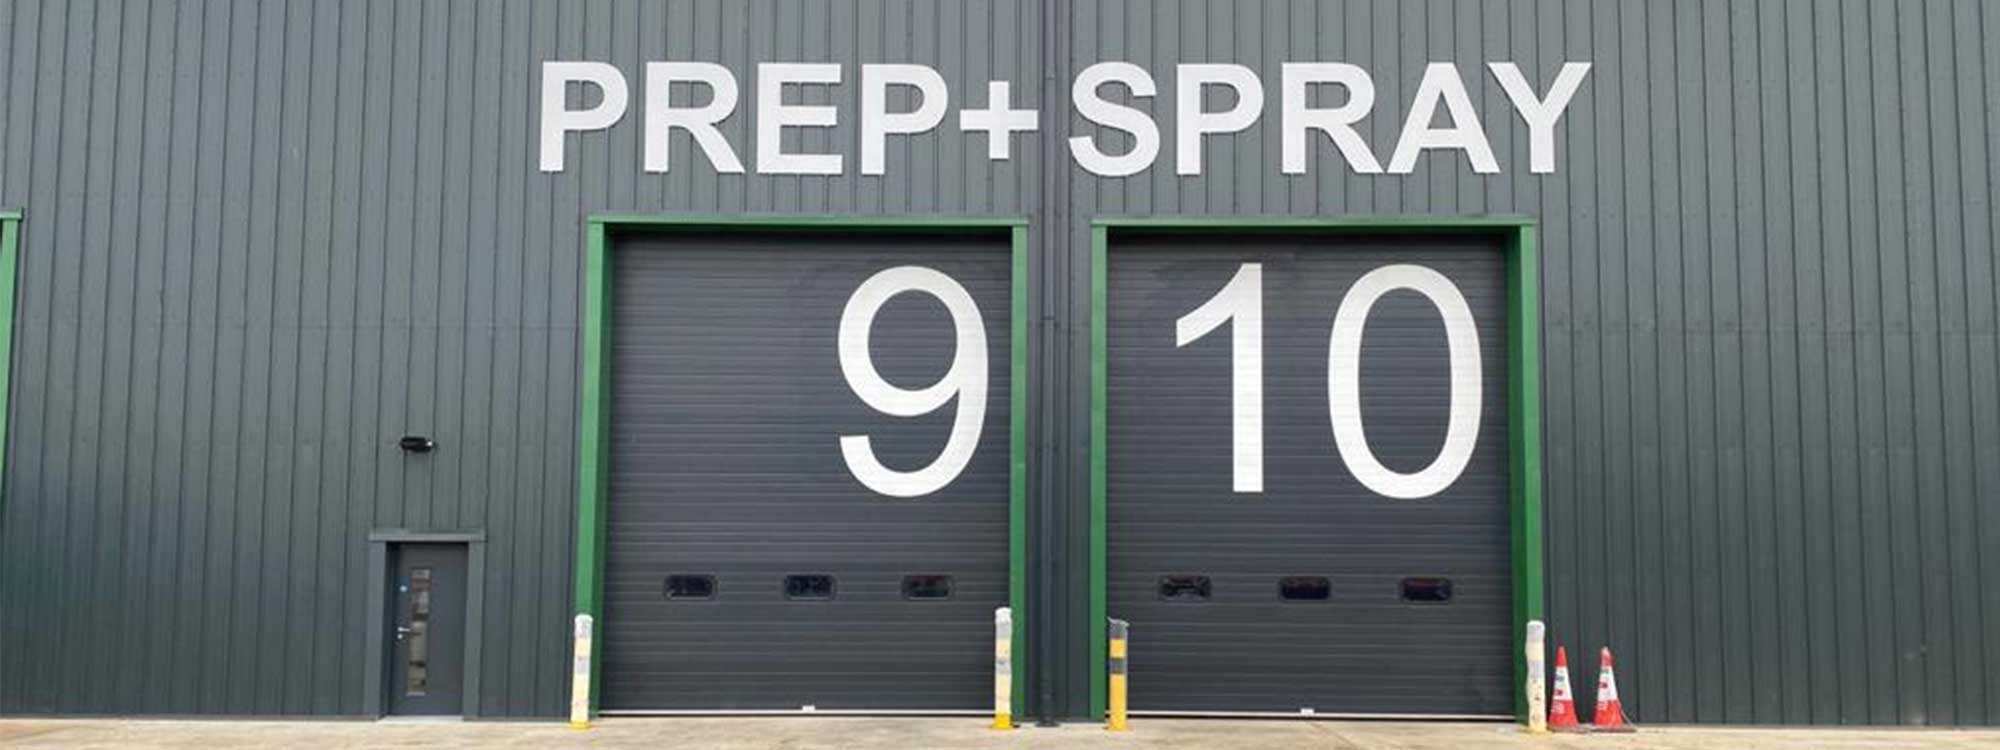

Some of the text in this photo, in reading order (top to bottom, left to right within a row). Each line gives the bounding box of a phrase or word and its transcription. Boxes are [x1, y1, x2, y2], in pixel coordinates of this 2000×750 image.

[539, 60, 1593, 177] PREP+ SPRAY
[837, 265, 989, 498] 9
[1175, 262, 1483, 499] 10
